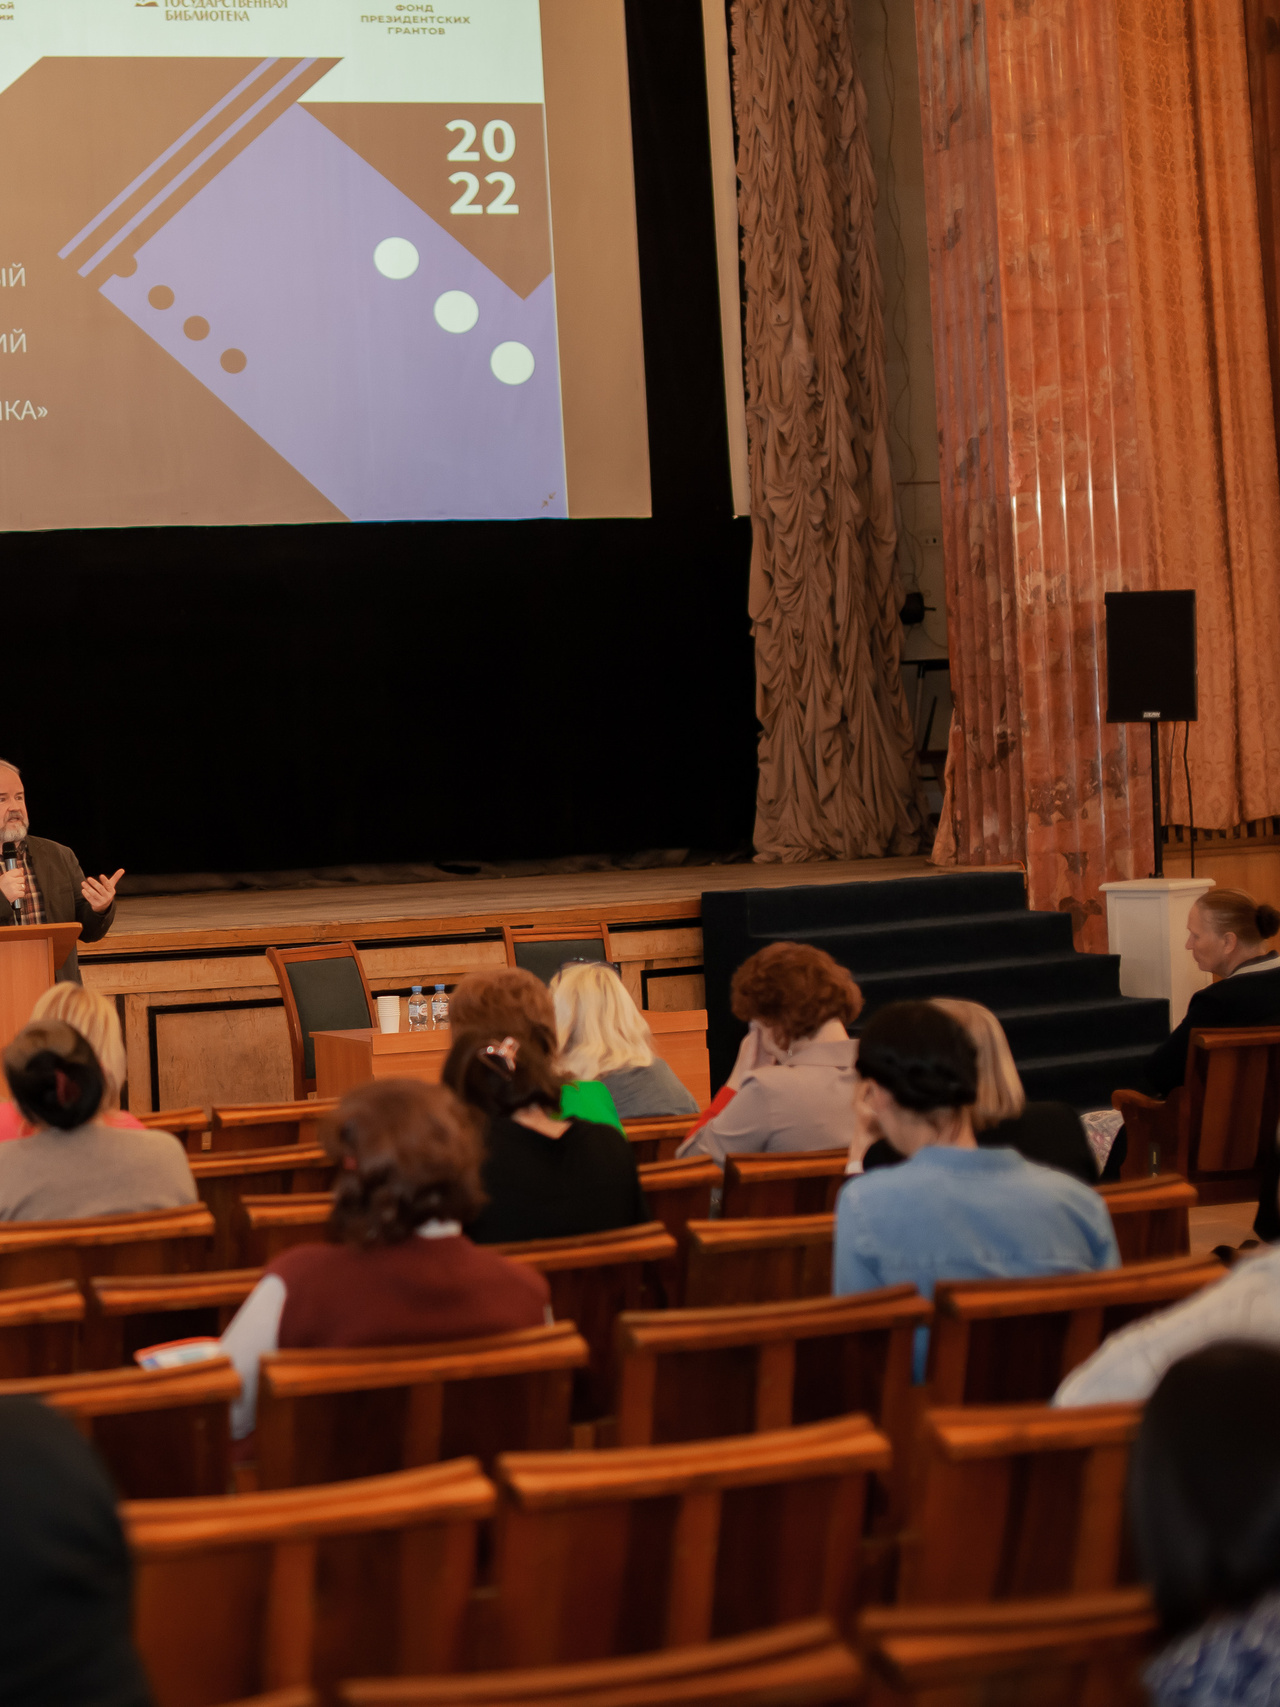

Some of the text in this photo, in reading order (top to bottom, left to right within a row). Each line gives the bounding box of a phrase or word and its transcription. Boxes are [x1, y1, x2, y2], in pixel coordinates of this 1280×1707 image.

[395, 4, 434, 13] ФОНД
[165, 10, 250, 22] БИБЛИОТЕКА
[360, 15, 471, 25] ПРЕЗИДЕНТСКИХ
[387, 27, 446, 35] ГРАНТОВ
[445, 119, 516, 162] 20
[448, 171, 519, 214] 22
